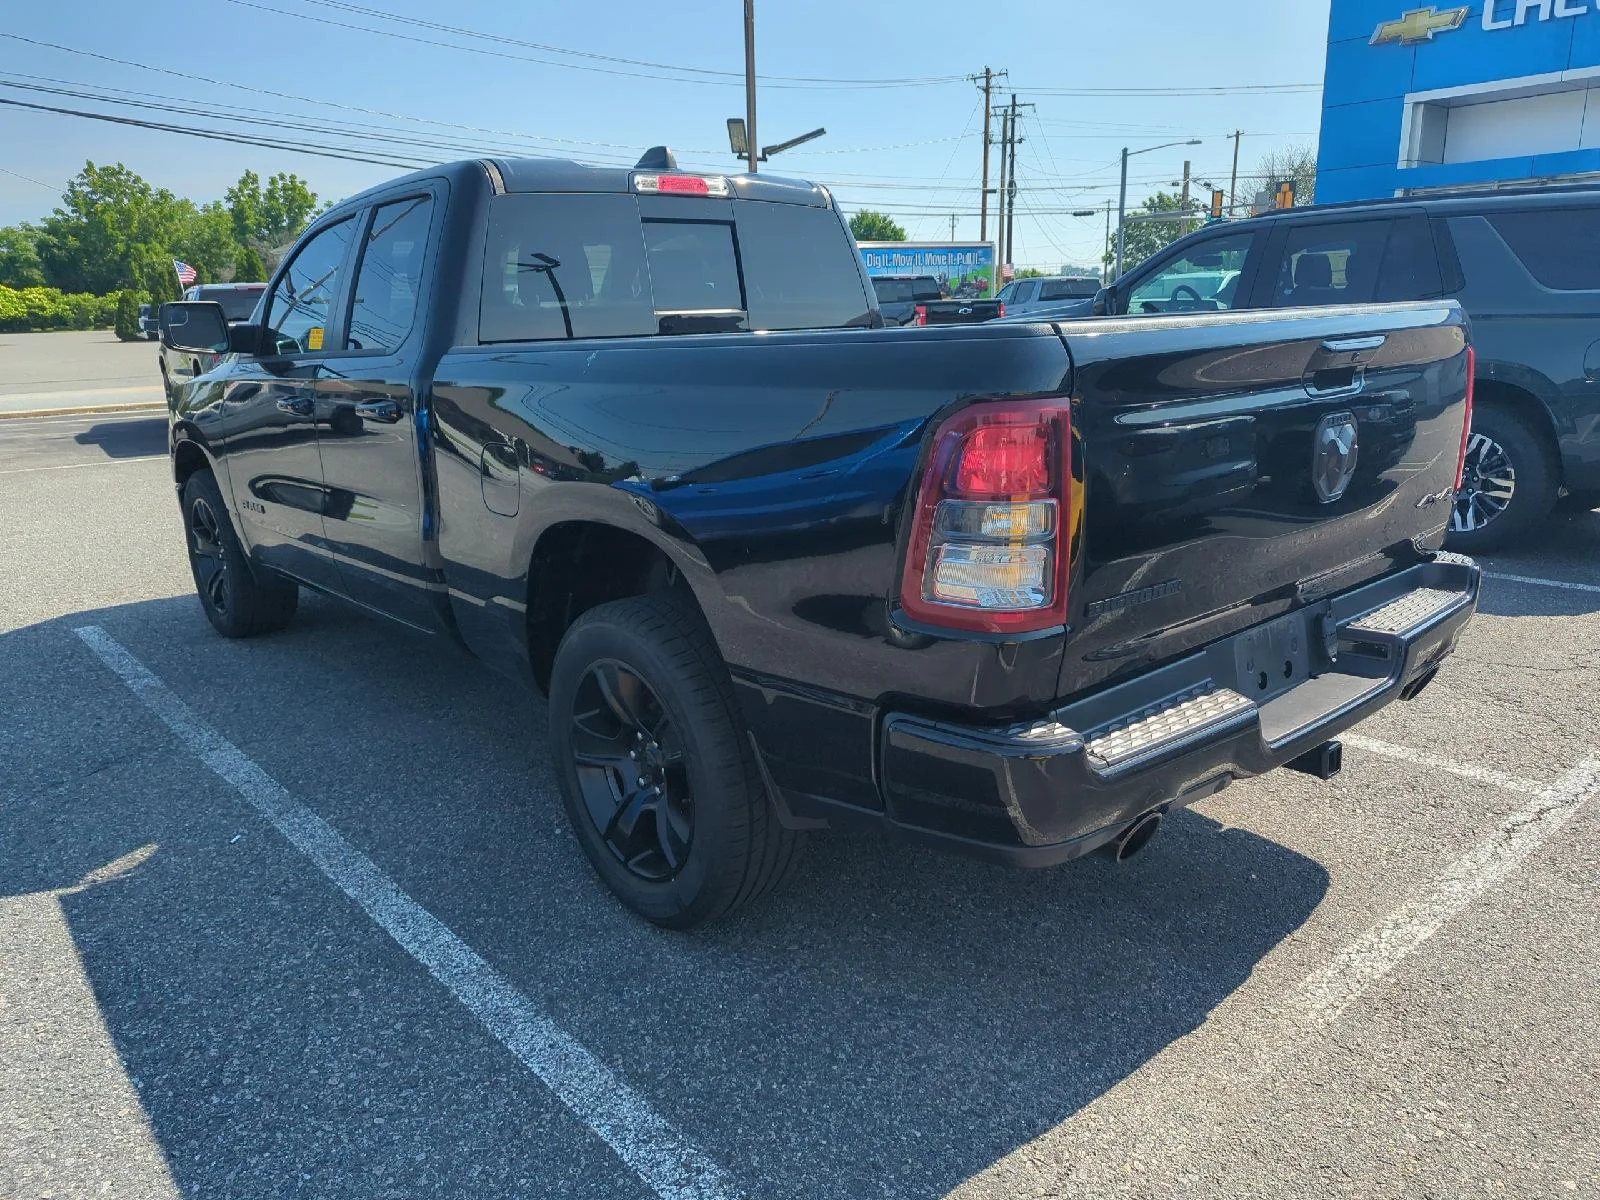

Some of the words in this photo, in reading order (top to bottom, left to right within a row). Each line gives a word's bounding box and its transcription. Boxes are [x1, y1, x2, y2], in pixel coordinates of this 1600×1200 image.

[866, 253, 881, 269] Dig
[893, 253, 914, 267] Mow
[925, 252, 947, 266] Move
[957, 252, 972, 265] Pull
